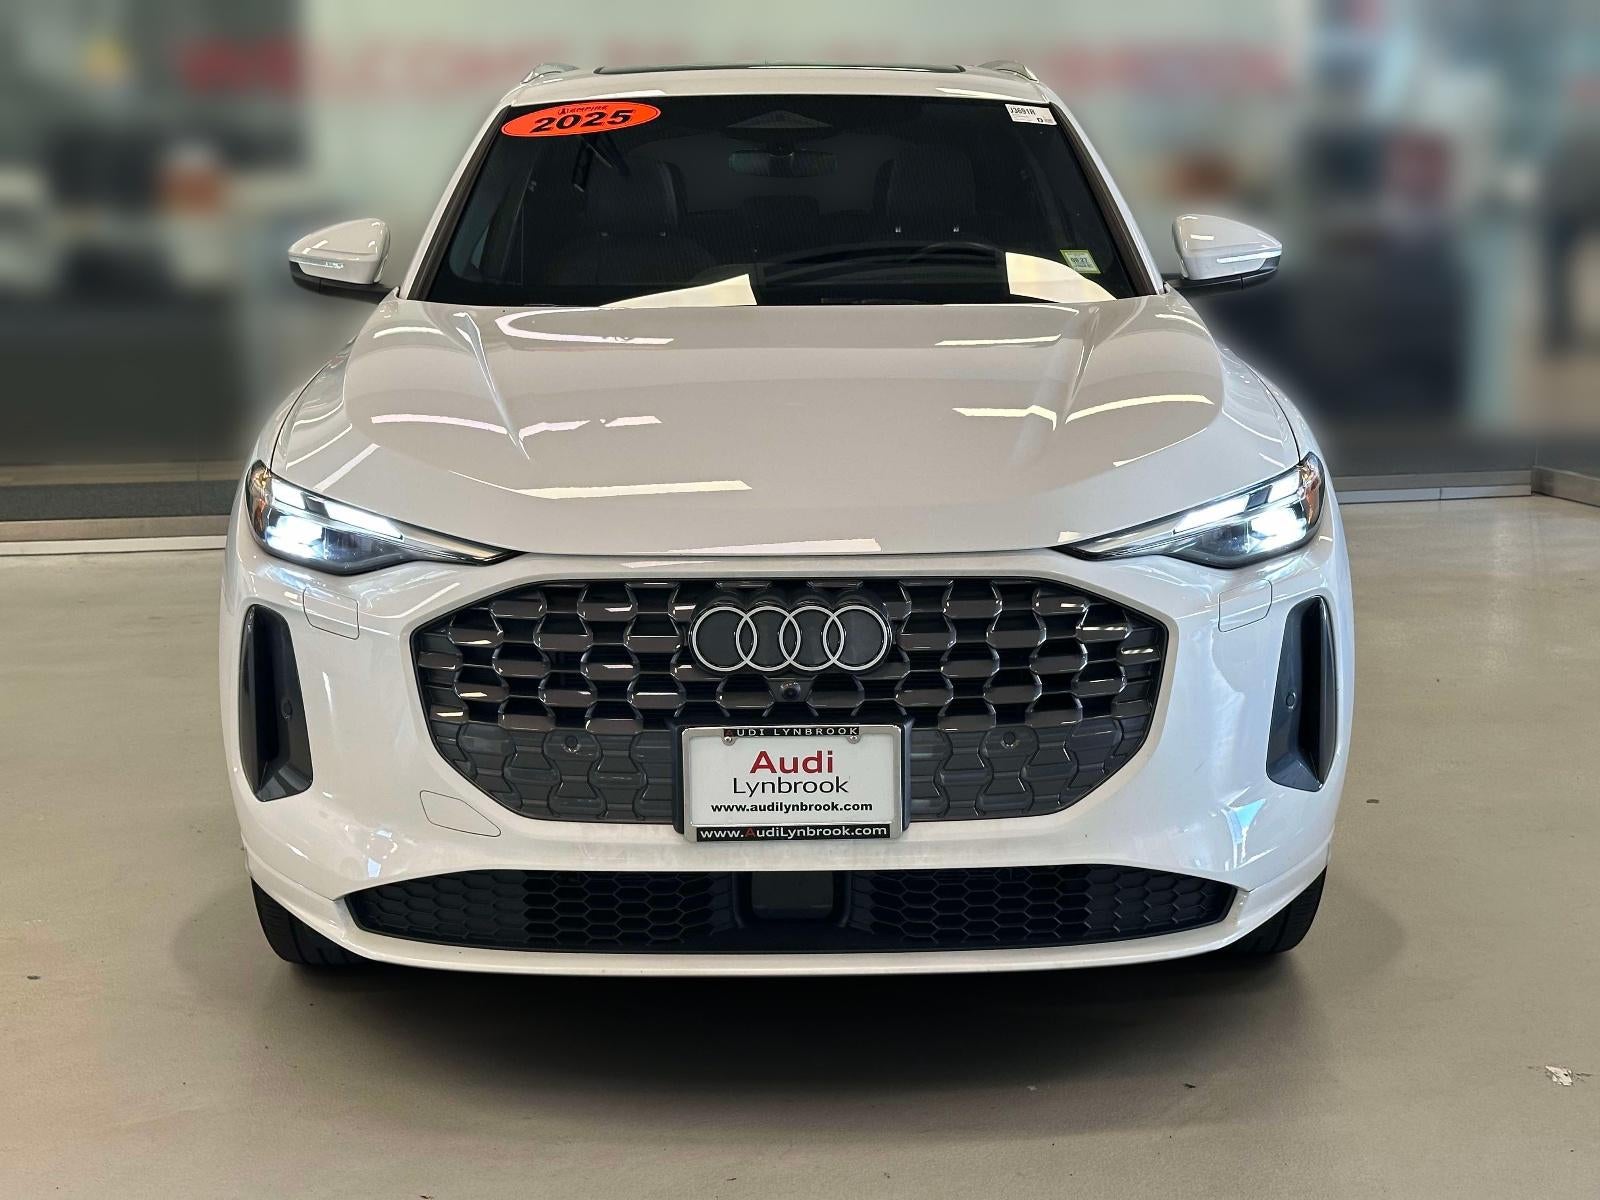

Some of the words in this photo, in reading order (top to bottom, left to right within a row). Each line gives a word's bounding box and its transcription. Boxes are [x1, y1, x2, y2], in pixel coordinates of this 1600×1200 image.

[530, 110, 633, 133] 2025
[724, 729, 765, 737] AUDI
[773, 727, 858, 736] LYNBROOK
[750, 750, 833, 774] Audi
[733, 776, 849, 797] Lynbrook
[711, 801, 873, 814] www.audilynbrook.com
[700, 826, 887, 839] www.AudiLynbrook.com
